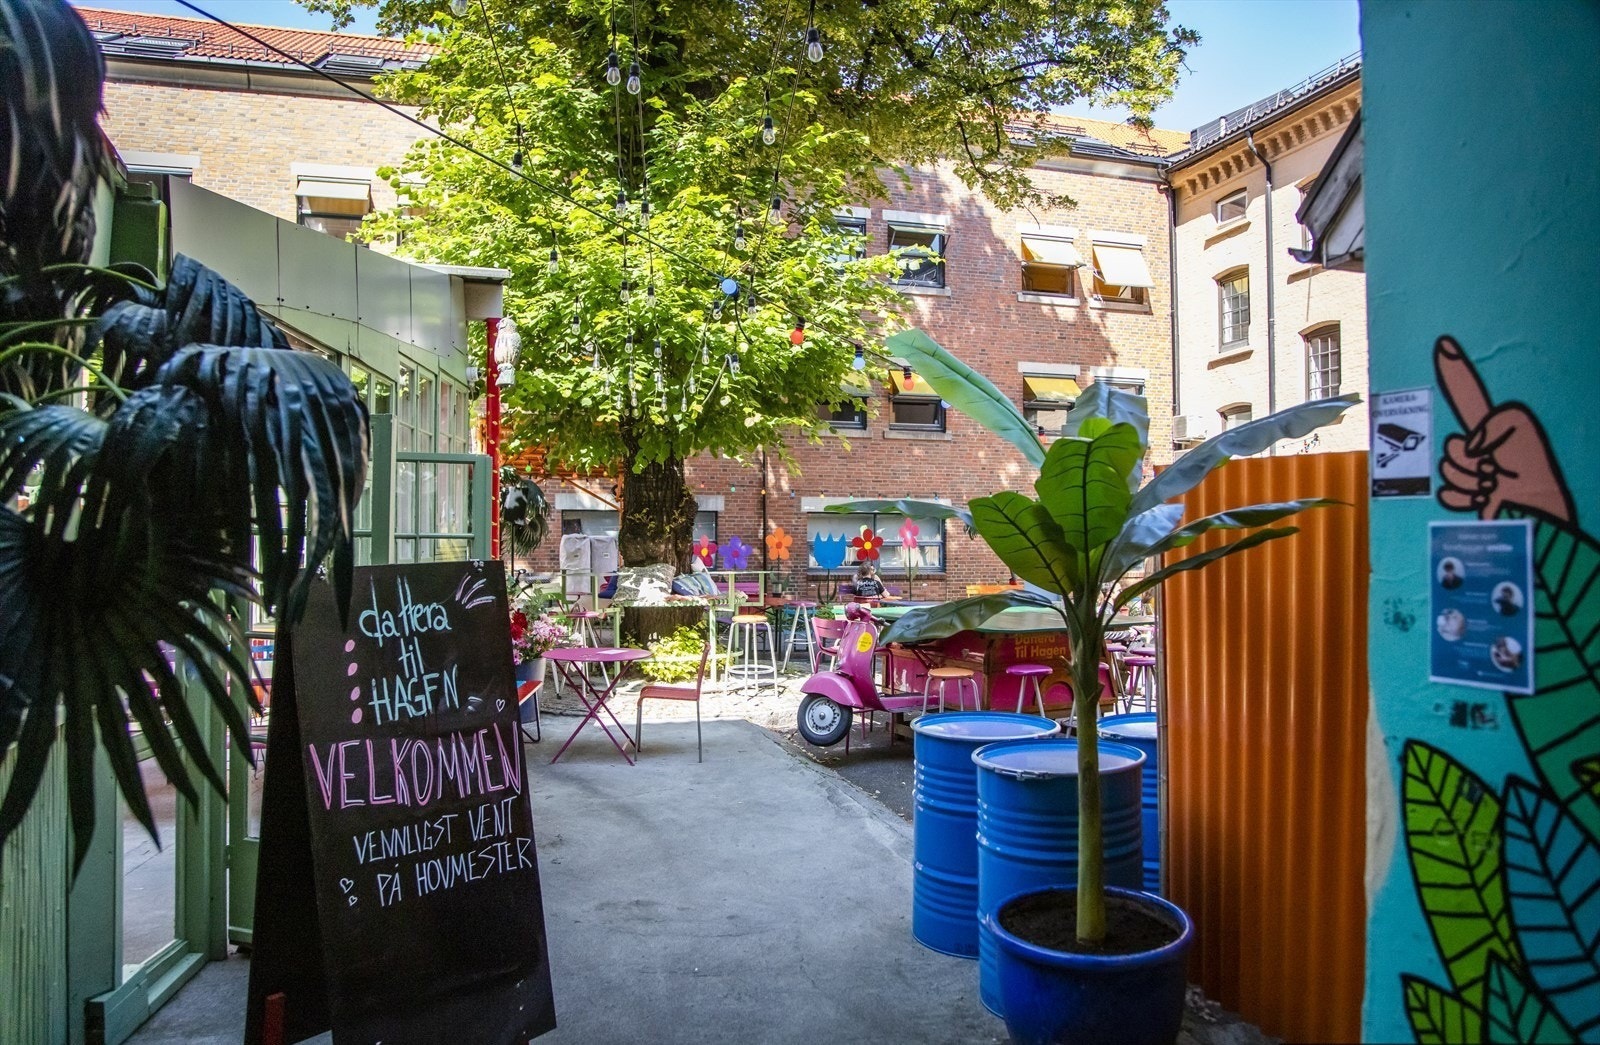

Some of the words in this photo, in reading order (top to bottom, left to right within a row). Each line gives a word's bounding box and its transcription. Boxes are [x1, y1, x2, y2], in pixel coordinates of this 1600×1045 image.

[399, 636, 425, 678] til
[1015, 645, 1027, 658] Til
[1031, 645, 1066, 659] Hagen
[309, 721, 521, 810] VELKOMMEN
[353, 814, 458, 864] VENNLIGST
[469, 796, 518, 841] VENT
[377, 863, 403, 907] PÅ
[416, 838, 533, 897] HOVMESTER
